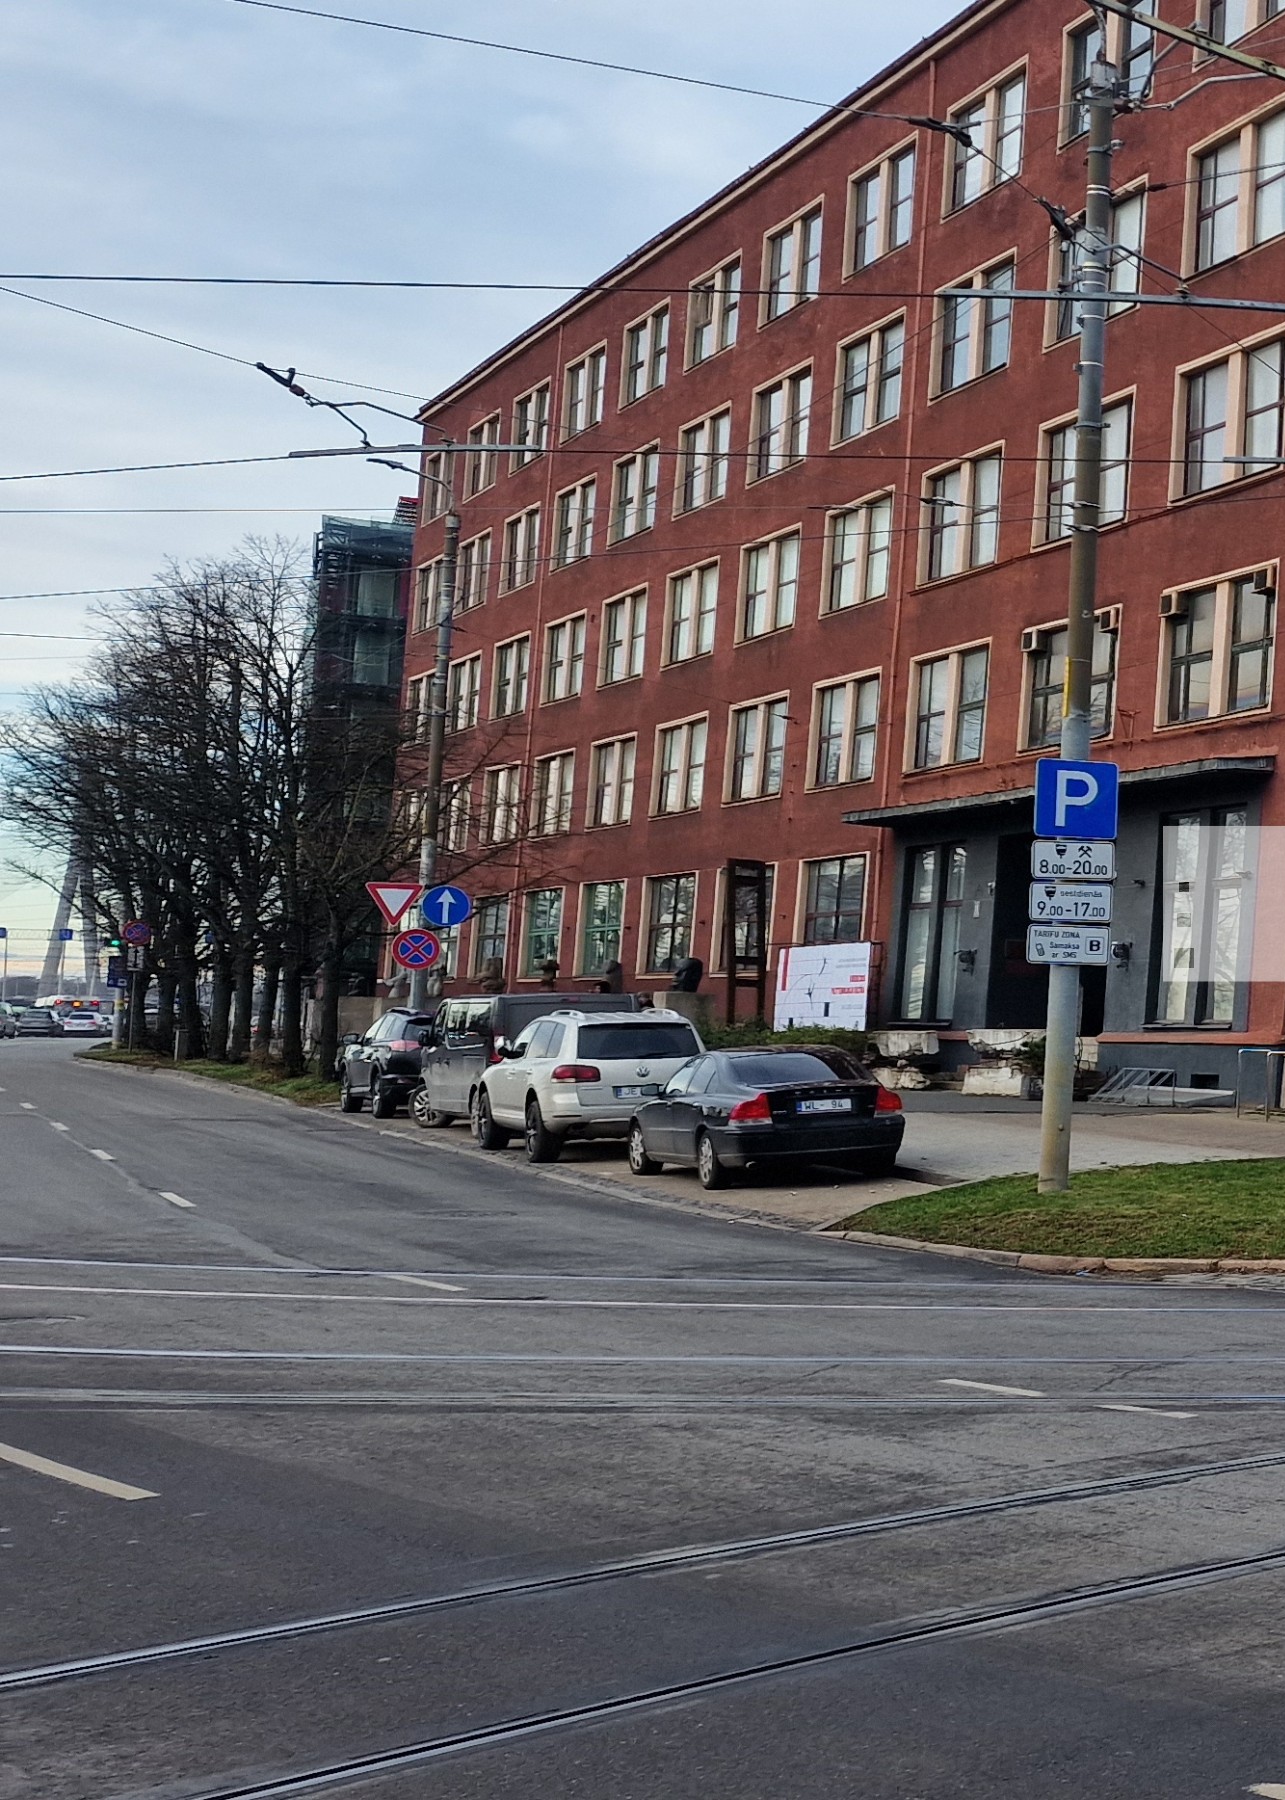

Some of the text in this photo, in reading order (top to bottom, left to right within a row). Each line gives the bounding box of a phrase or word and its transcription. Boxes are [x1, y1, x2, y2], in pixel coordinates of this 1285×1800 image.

[1055, 770, 1098, 827] P
[1039, 859, 1108, 876] 8.00-20.00
[1037, 901, 1106, 918] 9.00-17.00
[1034, 930, 1059, 938] TARIFU
[1089, 940, 1100, 952] B
